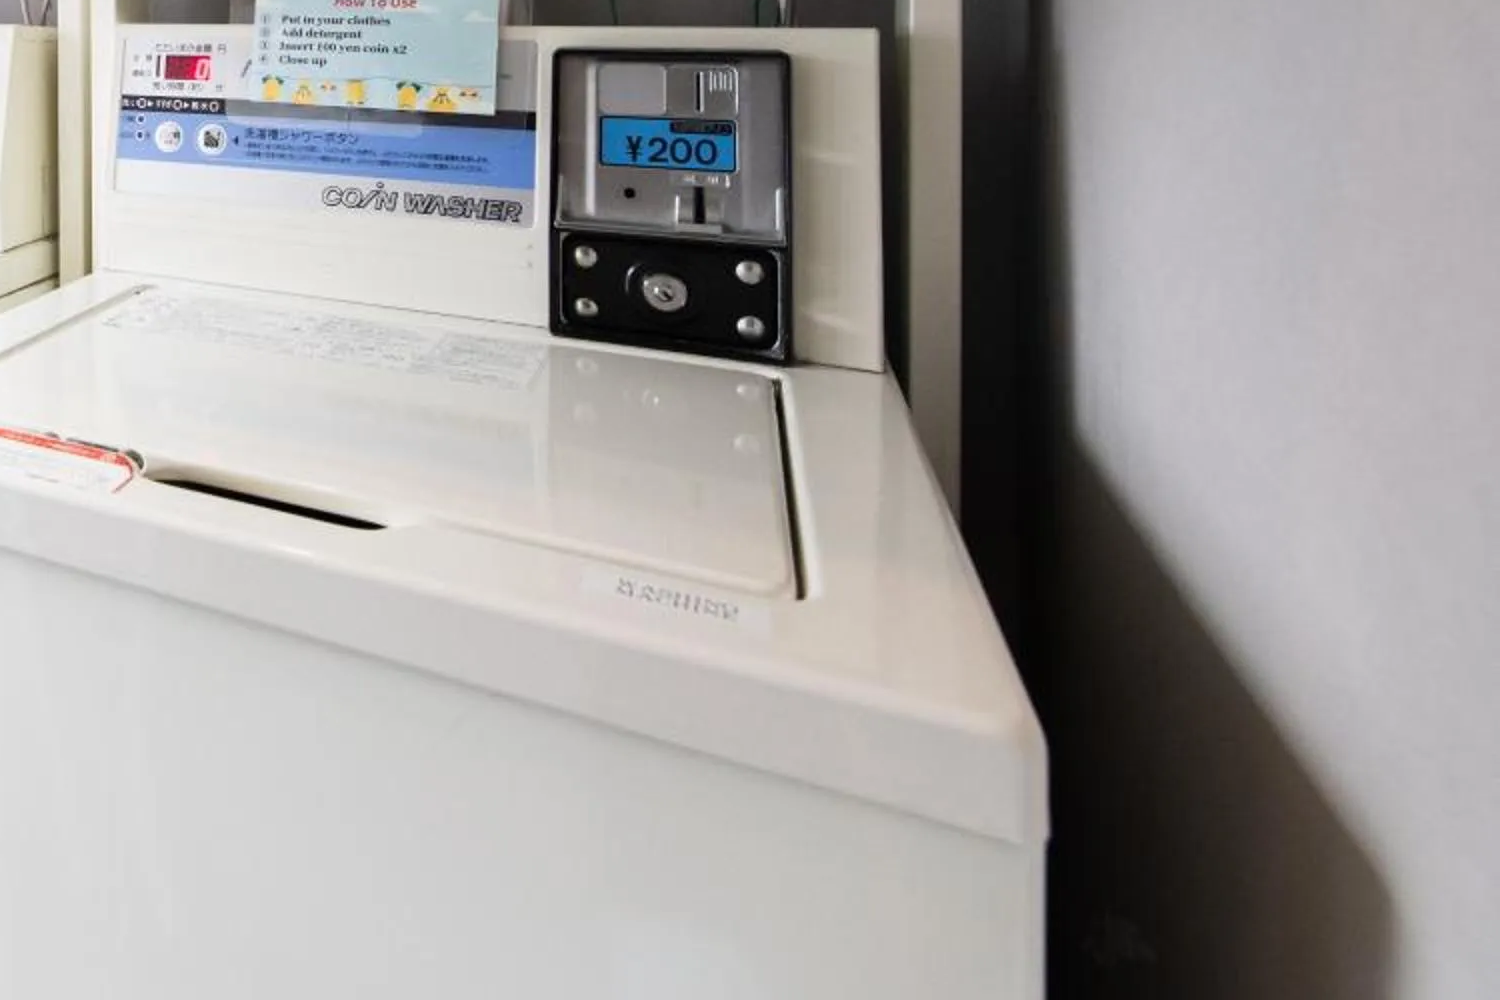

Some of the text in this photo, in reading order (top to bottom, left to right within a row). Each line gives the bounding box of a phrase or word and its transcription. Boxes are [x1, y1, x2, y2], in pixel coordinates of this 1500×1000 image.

[281, 15, 300, 26] Put
[316, 17, 344, 28] your
[347, 16, 391, 26] clothes
[281, 28, 303, 38] Add
[305, 29, 362, 41] detergent
[279, 41, 313, 52] Insert
[316, 43, 337, 53] 100
[339, 44, 361, 55] yen
[363, 44, 390, 55] coin
[279, 55, 308, 65] Close
[312, 58, 327, 68] up
[196, 58, 210, 80] 0
[625, 135, 718, 165] ¥200
[403, 191, 524, 223] WASHER
